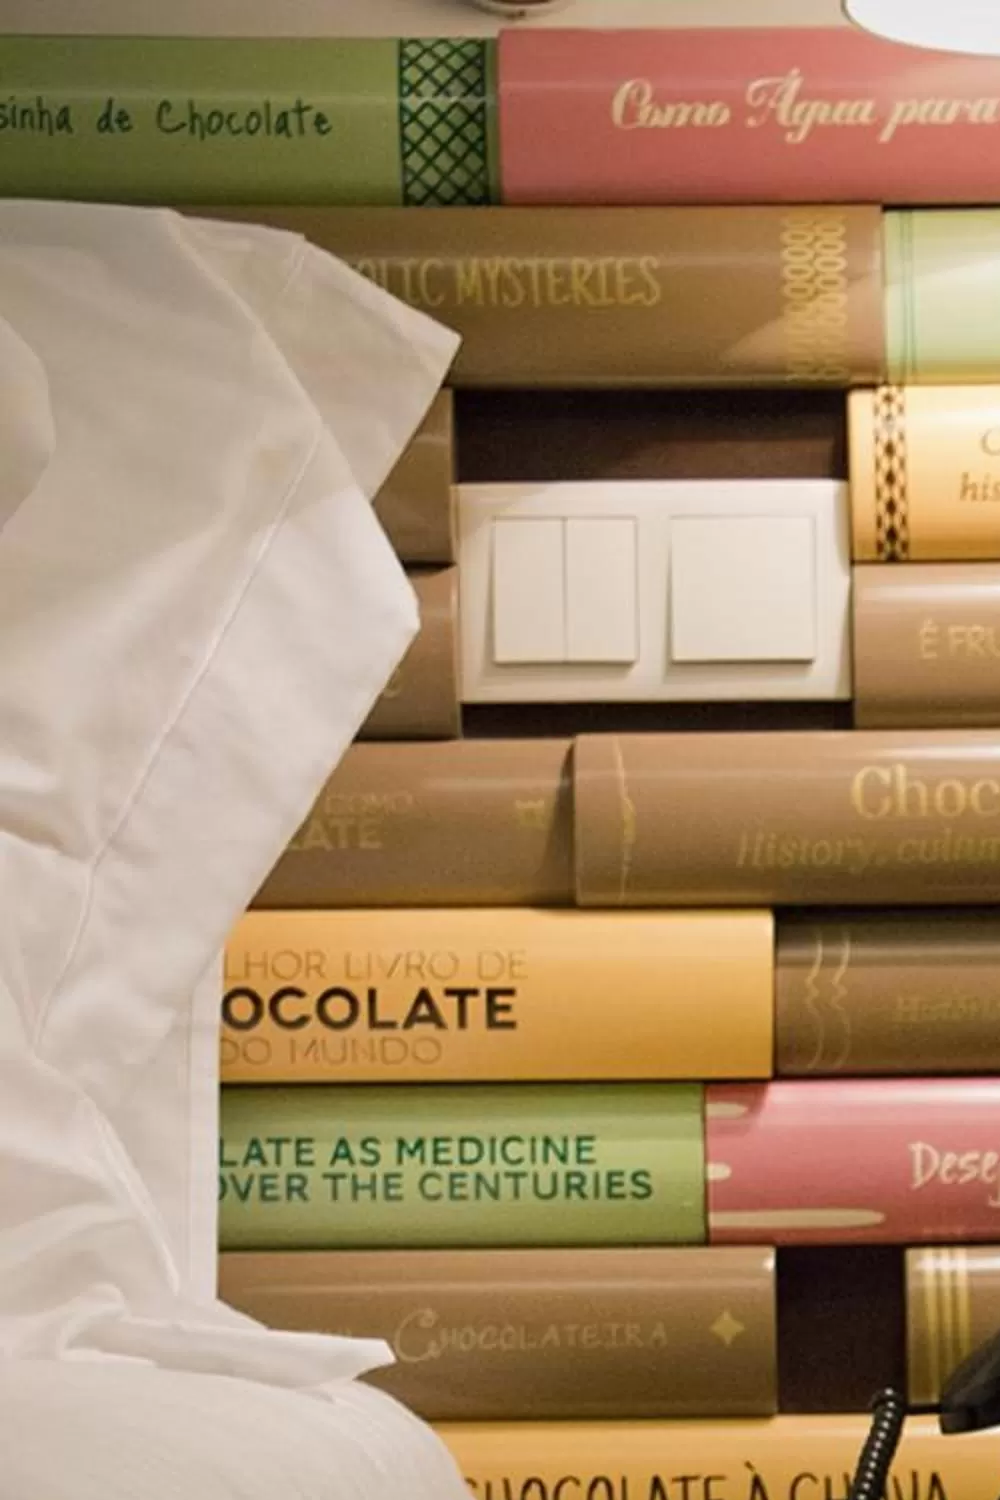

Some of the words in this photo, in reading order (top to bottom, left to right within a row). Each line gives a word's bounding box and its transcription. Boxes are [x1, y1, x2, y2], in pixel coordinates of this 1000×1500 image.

[96, 96, 133, 133] de
[156, 98, 333, 141] Chocolate
[610, 78, 731, 129] Como
[744, 68, 877, 144] Água
[878, 96, 1000, 143] para
[457, 255, 662, 308] MYSTERIES
[919, 617, 939, 659] É
[292, 818, 382, 850] ATE
[344, 949, 459, 981] LIVRO
[477, 949, 529, 981] DE
[221, 986, 517, 1030] OCOLATE
[288, 1035, 443, 1067] MUNDO
[219, 1136, 315, 1168] LATE
[329, 1137, 382, 1168] AS
[395, 1134, 597, 1166] MEDICINE
[322, 1171, 404, 1202] THE
[418, 1169, 653, 1201] CENTURIES
